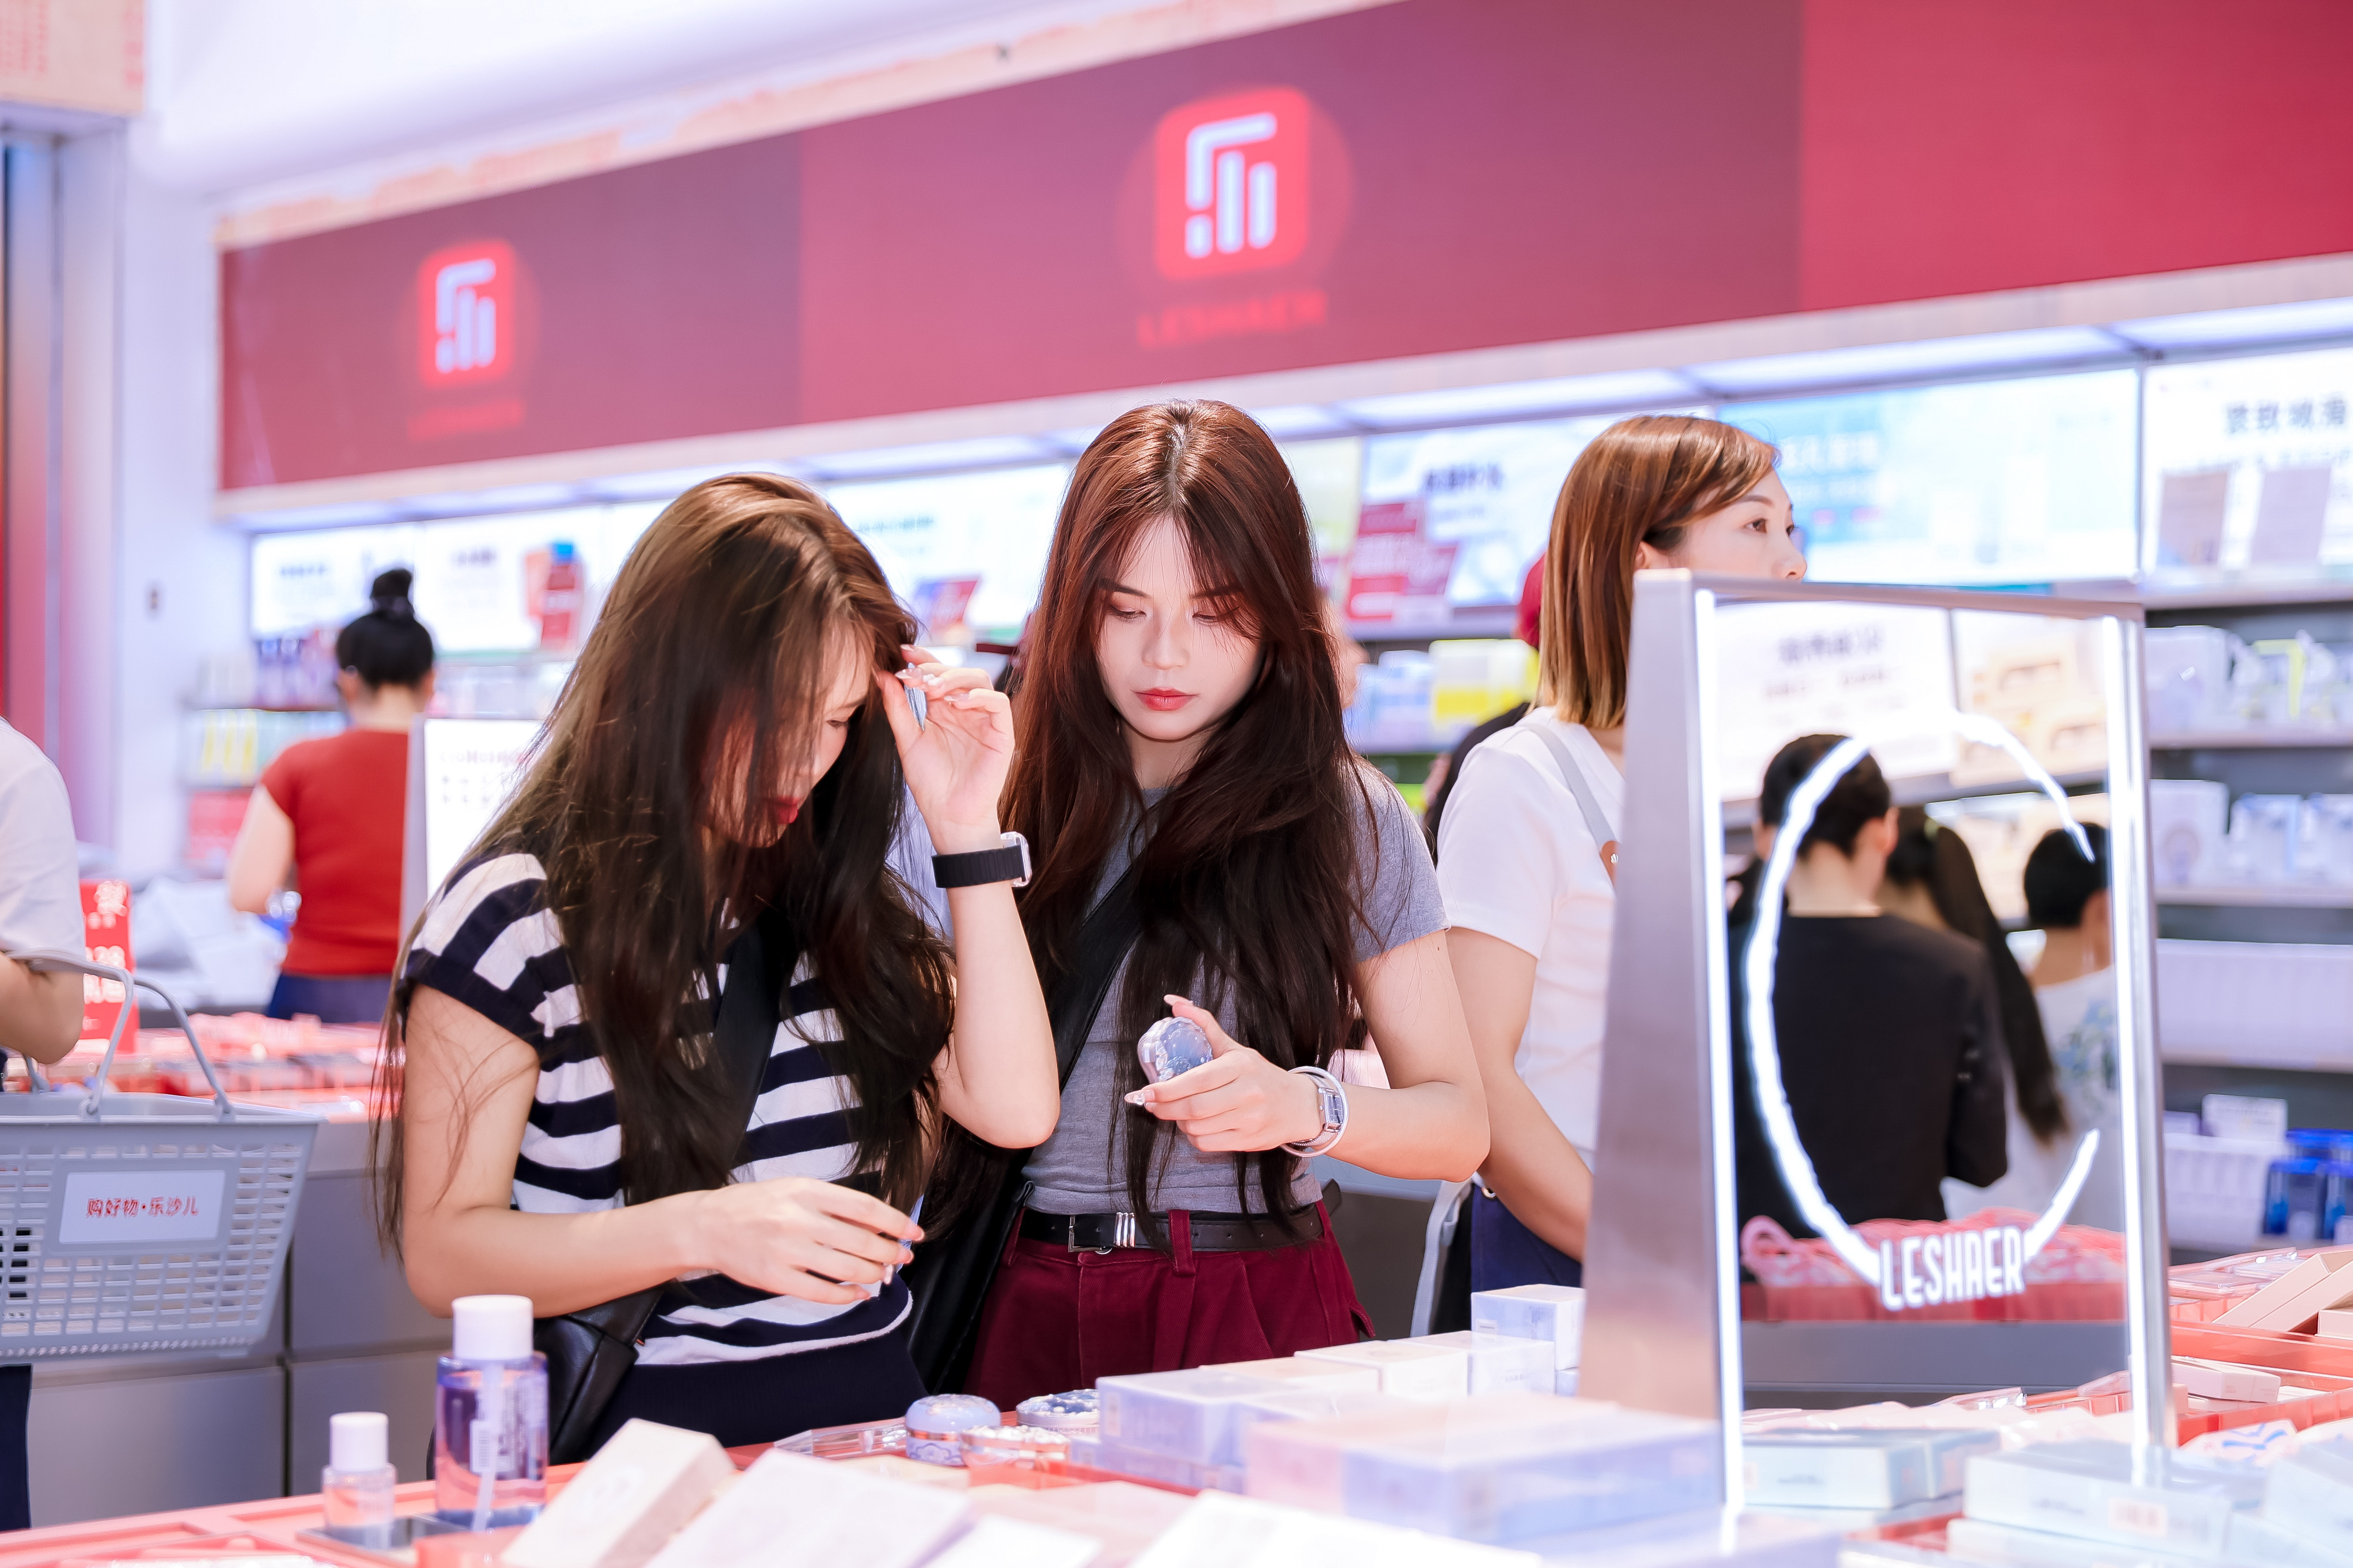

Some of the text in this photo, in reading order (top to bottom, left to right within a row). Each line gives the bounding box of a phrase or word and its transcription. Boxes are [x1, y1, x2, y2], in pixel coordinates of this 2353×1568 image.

[86, 1196, 199, 1218] 购好物·乐沙儿
[1880, 1226, 2025, 1311] LESHAER
